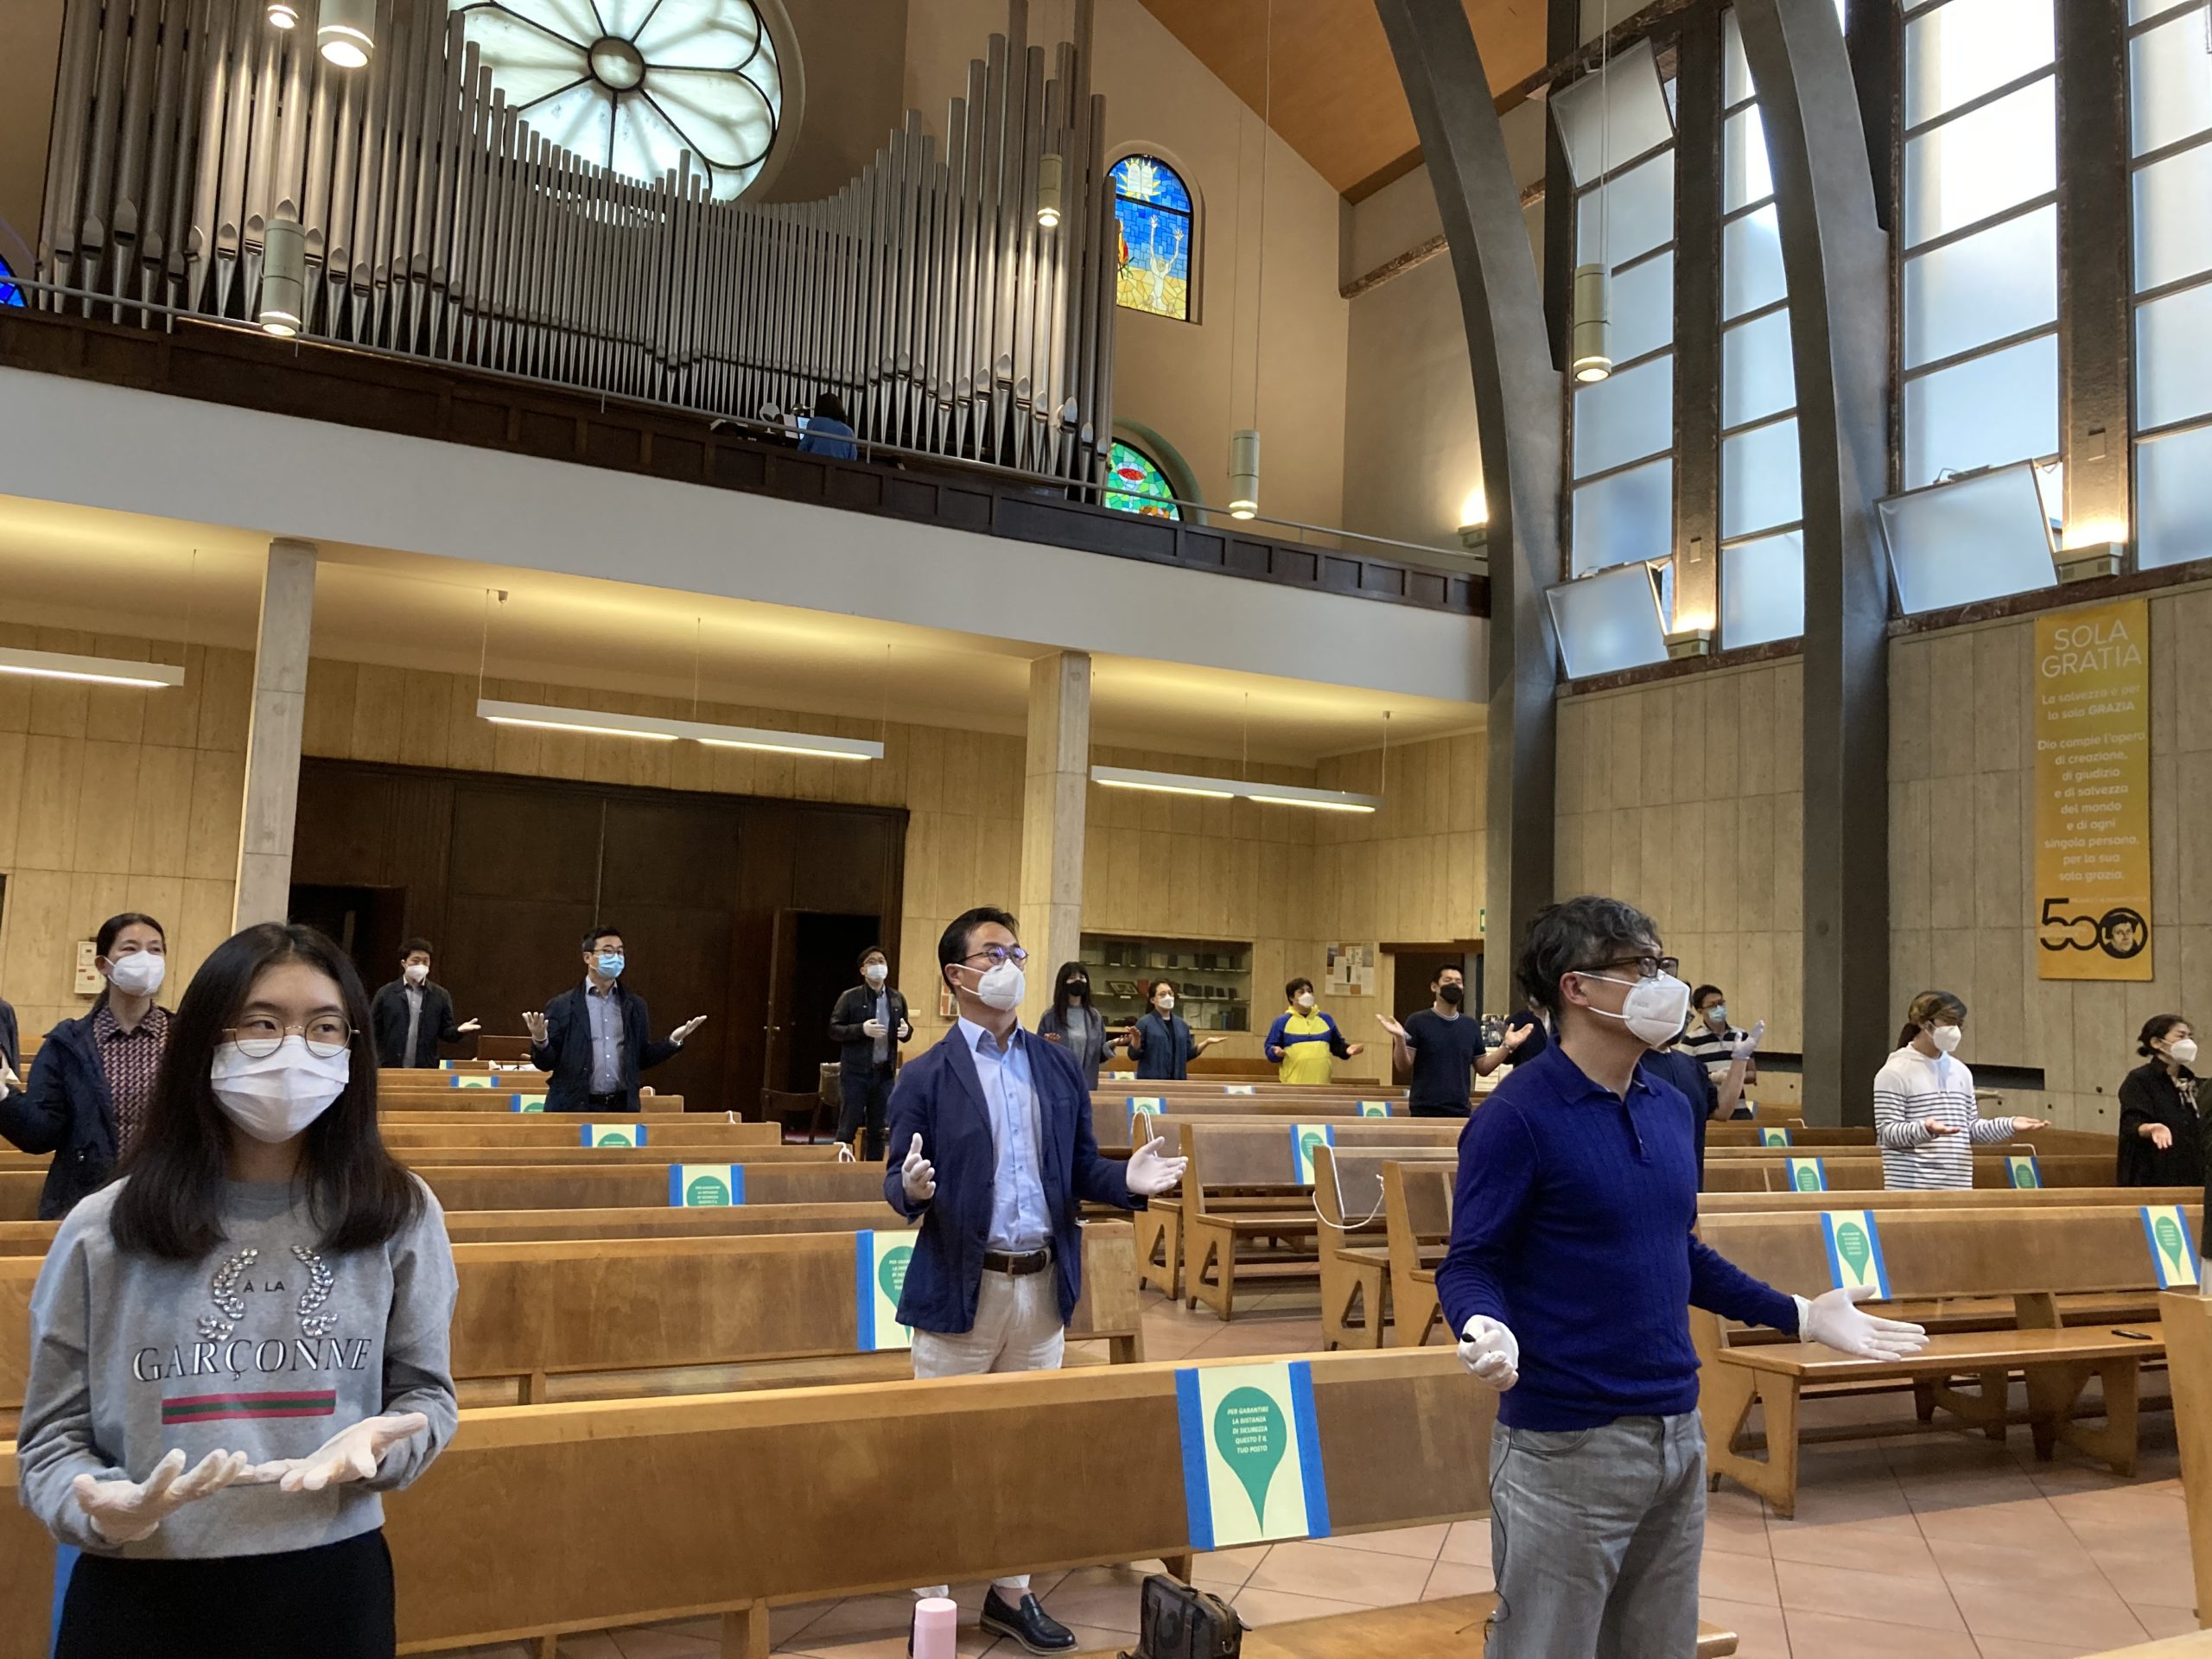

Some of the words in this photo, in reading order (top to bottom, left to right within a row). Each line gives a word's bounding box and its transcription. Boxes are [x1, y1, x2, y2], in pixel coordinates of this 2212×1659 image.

[2054, 619, 2128, 651] SOLA
[2041, 644, 2142, 678] GRATIA
[2042, 695, 2056, 705] La
[2058, 690, 2107, 703] salvezza
[2121, 684, 2141, 696] per
[2048, 711, 2058, 721] la
[2062, 707, 2085, 719] sola
[2088, 701, 2135, 715] GRAZIA
[2037, 740, 2057, 751] Dio
[2060, 735, 2101, 748] compie
[2055, 754, 2065, 766] di
[2062, 770, 2072, 781] di
[2075, 768, 2120, 783] giudizio
[2054, 790, 2062, 798] e
[2064, 787, 2075, 798] di
[2077, 785, 2128, 797] salvezza
[2061, 804, 2078, 814] del
[2082, 801, 2122, 813] mondo
[2066, 822, 2074, 830] e
[2076, 819, 2087, 830] di
[2090, 818, 2115, 831] ogni
[2044, 836, 2085, 850] singola
[2063, 855, 2081, 867] per
[2084, 853, 2095, 863] la
[2099, 854, 2120, 863] sua
[2059, 870, 2082, 881] sola
[264, 1281, 285, 1292] LA
[132, 1338, 372, 1382] GARÇONNE
[1238, 1406, 1268, 1414] GARANTIRE
[1240, 1426, 1268, 1434] SICUREZZA
[1236, 1436, 1257, 1445] QUESTO
